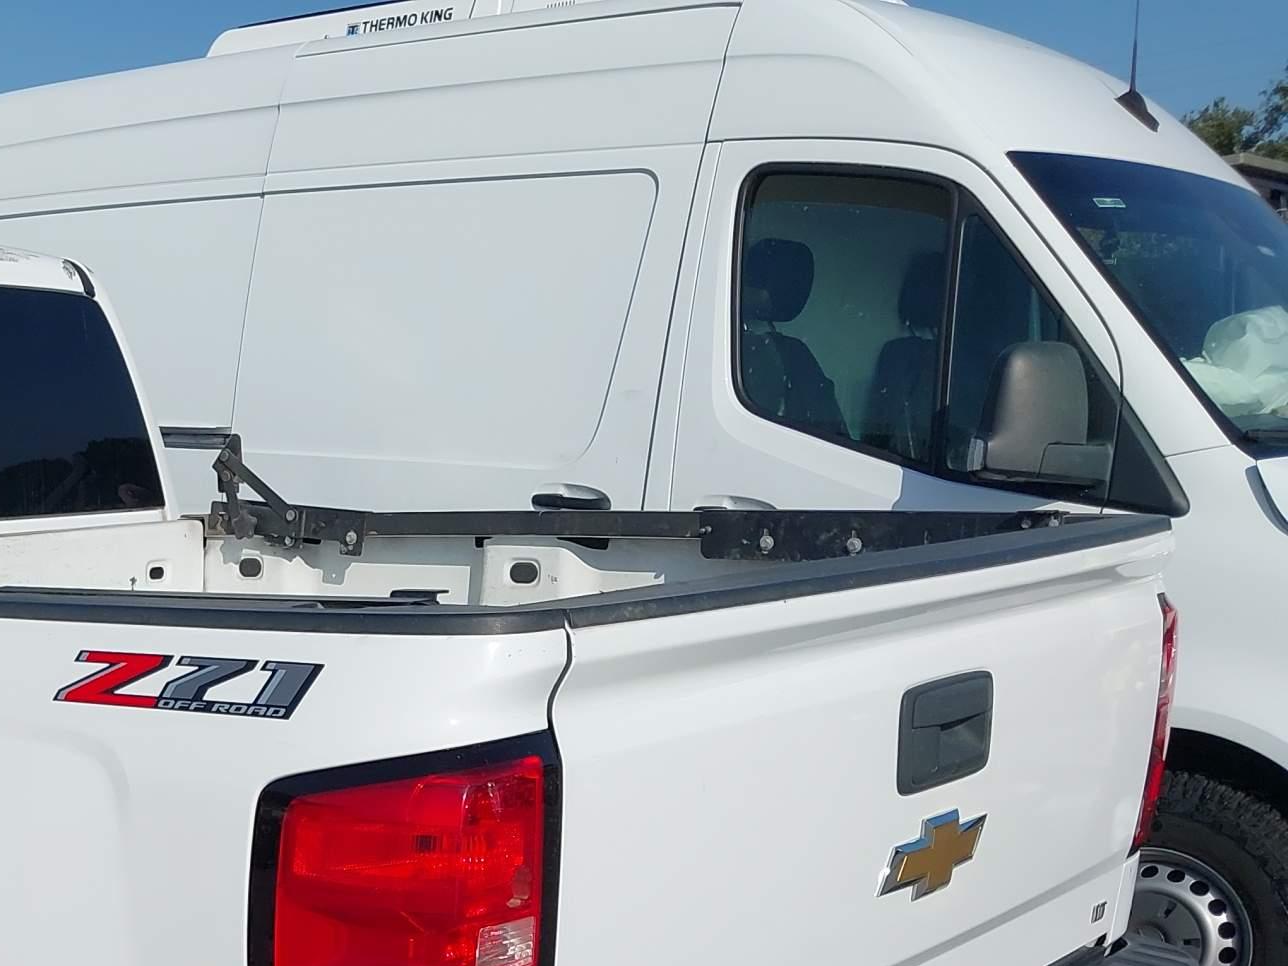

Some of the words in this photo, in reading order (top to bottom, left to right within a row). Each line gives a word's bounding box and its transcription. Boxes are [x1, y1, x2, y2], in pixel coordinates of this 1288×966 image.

[362, 14, 418, 34] THERMO
[420, 8, 454, 25] KING
[53, 650, 325, 720] Z71
[158, 700, 206, 711] OFF
[211, 703, 286, 717] ROAD
